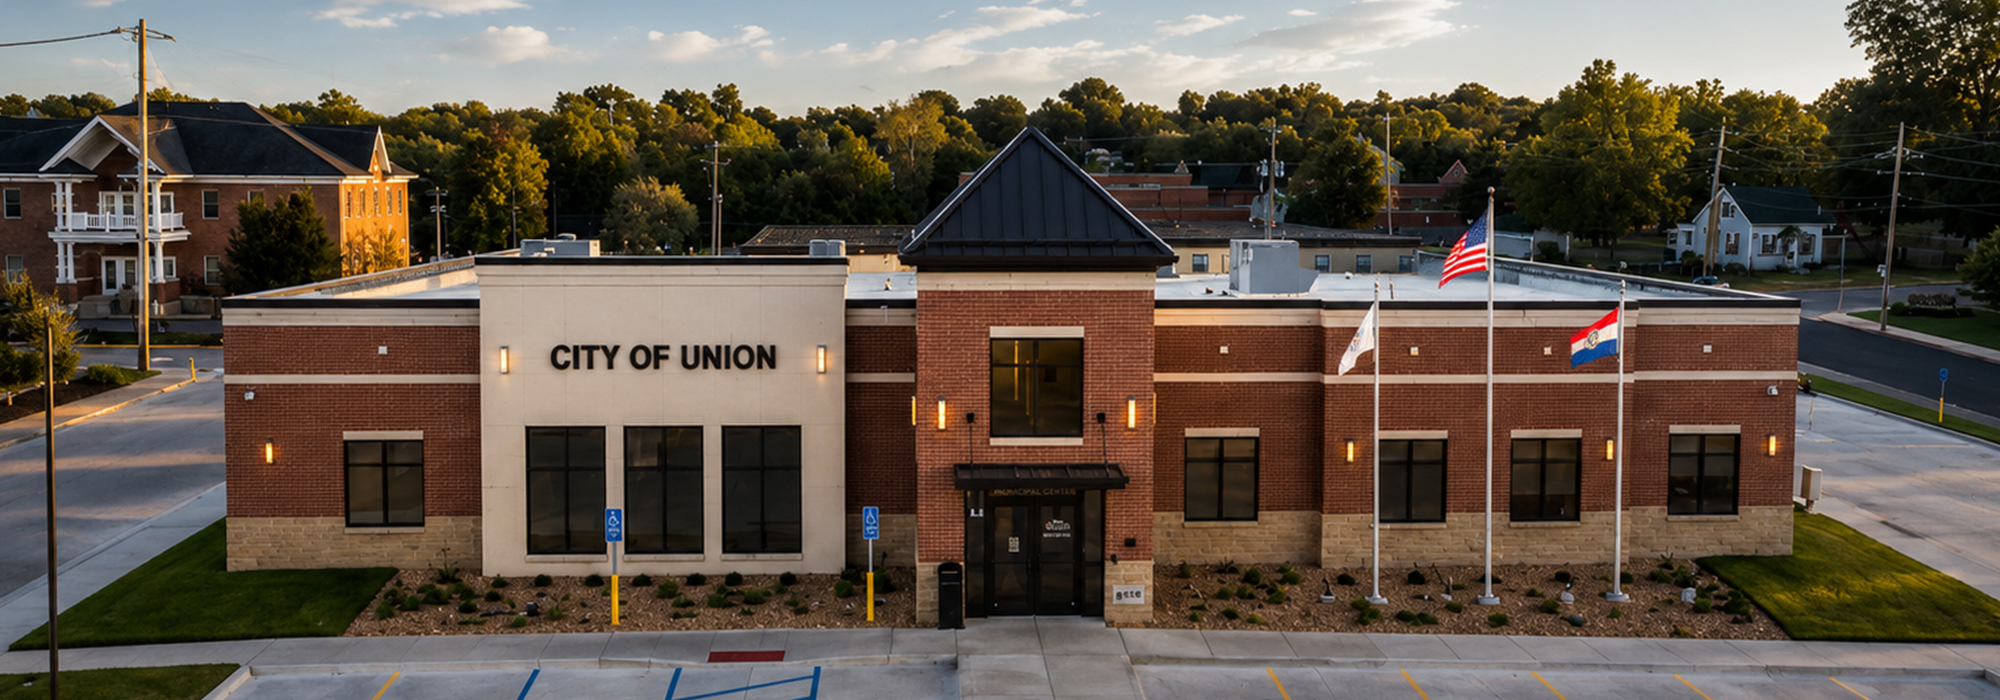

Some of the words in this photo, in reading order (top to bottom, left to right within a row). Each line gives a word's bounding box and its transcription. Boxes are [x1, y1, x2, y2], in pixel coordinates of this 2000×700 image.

[550, 345, 620, 370] CITY
[629, 345, 670, 370] OF
[681, 345, 776, 370] UNION
